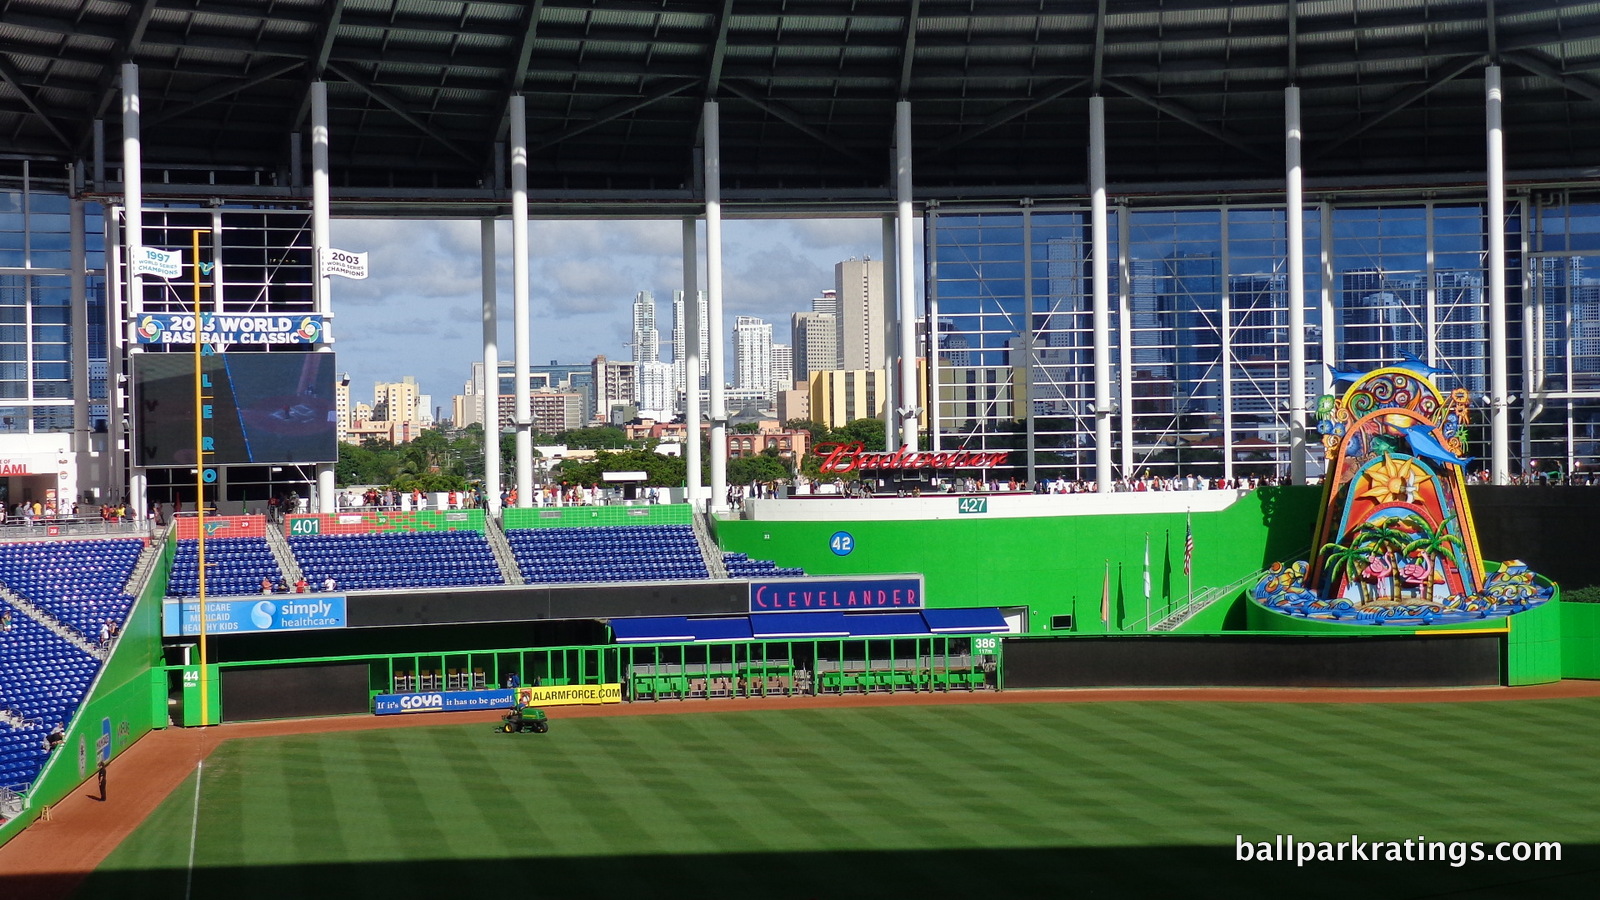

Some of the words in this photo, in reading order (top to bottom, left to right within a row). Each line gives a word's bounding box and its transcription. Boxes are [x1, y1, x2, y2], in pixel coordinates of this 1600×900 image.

[146, 250, 170, 263] 1997
[332, 252, 359, 265] 2003
[138, 265, 178, 275] CHAMPIONS
[327, 266, 364, 276] CHAMPIONS
[220, 317, 292, 332] WORLD
[240, 332, 299, 344] CLASSIC
[813, 440, 1008, 474] Budweiser
[960, 498, 985, 512] 427
[293, 519, 318, 533] 401
[832, 537, 851, 550] 42
[756, 586, 915, 607] CLEVELANDER
[282, 600, 332, 617] simply
[183, 623, 217, 632] HEALHY
[219, 622, 239, 630] KIDS
[282, 617, 336, 627] healthcare
[975, 638, 996, 648] 386
[184, 670, 199, 681] 44
[533, 688, 620, 701] ALARMFORCE.COM
[377, 701, 385, 709] If
[387, 701, 399, 709] it's
[400, 694, 442, 709] GOYA
[446, 698, 452, 706] it
[479, 696, 488, 704] be
[490, 695, 513, 706] good!
